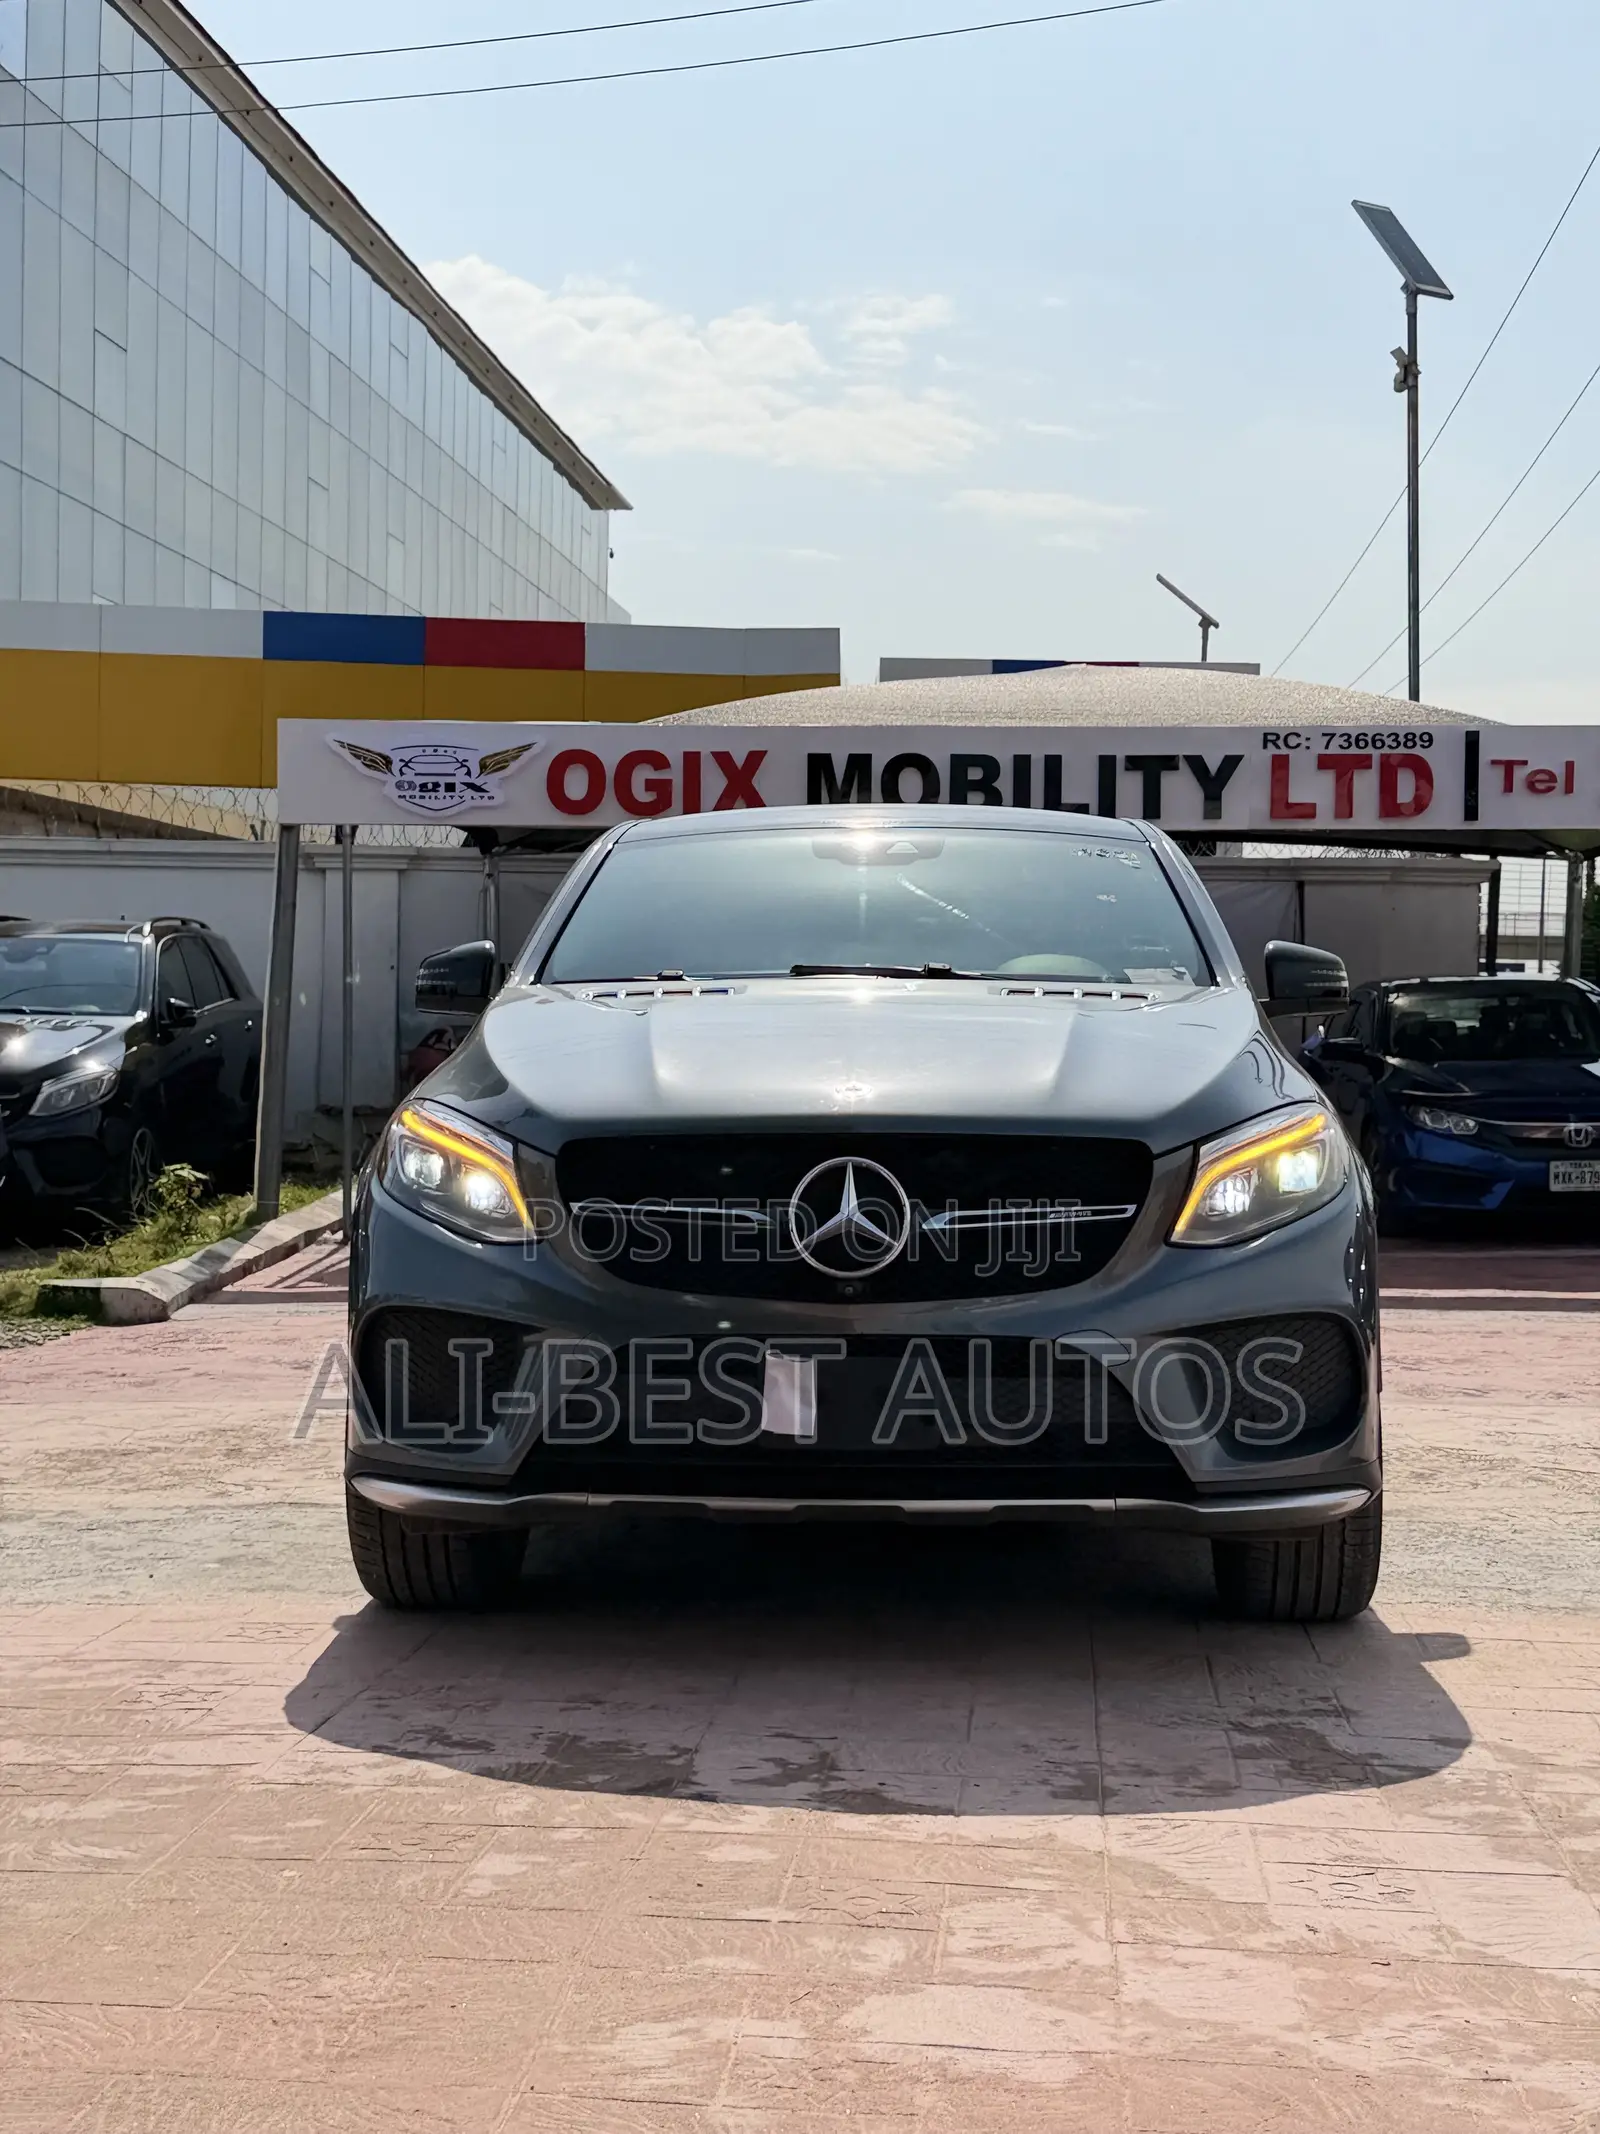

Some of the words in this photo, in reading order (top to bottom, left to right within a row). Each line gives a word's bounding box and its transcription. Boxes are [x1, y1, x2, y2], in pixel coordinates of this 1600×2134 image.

[1262, 732, 1311, 750] RC:
[1321, 731, 1434, 749] 7366389
[546, 748, 768, 816] OGIX
[807, 752, 1245, 820] MOBILITY
[1270, 753, 1434, 819] LTD
[1490, 759, 1576, 795] Tel
